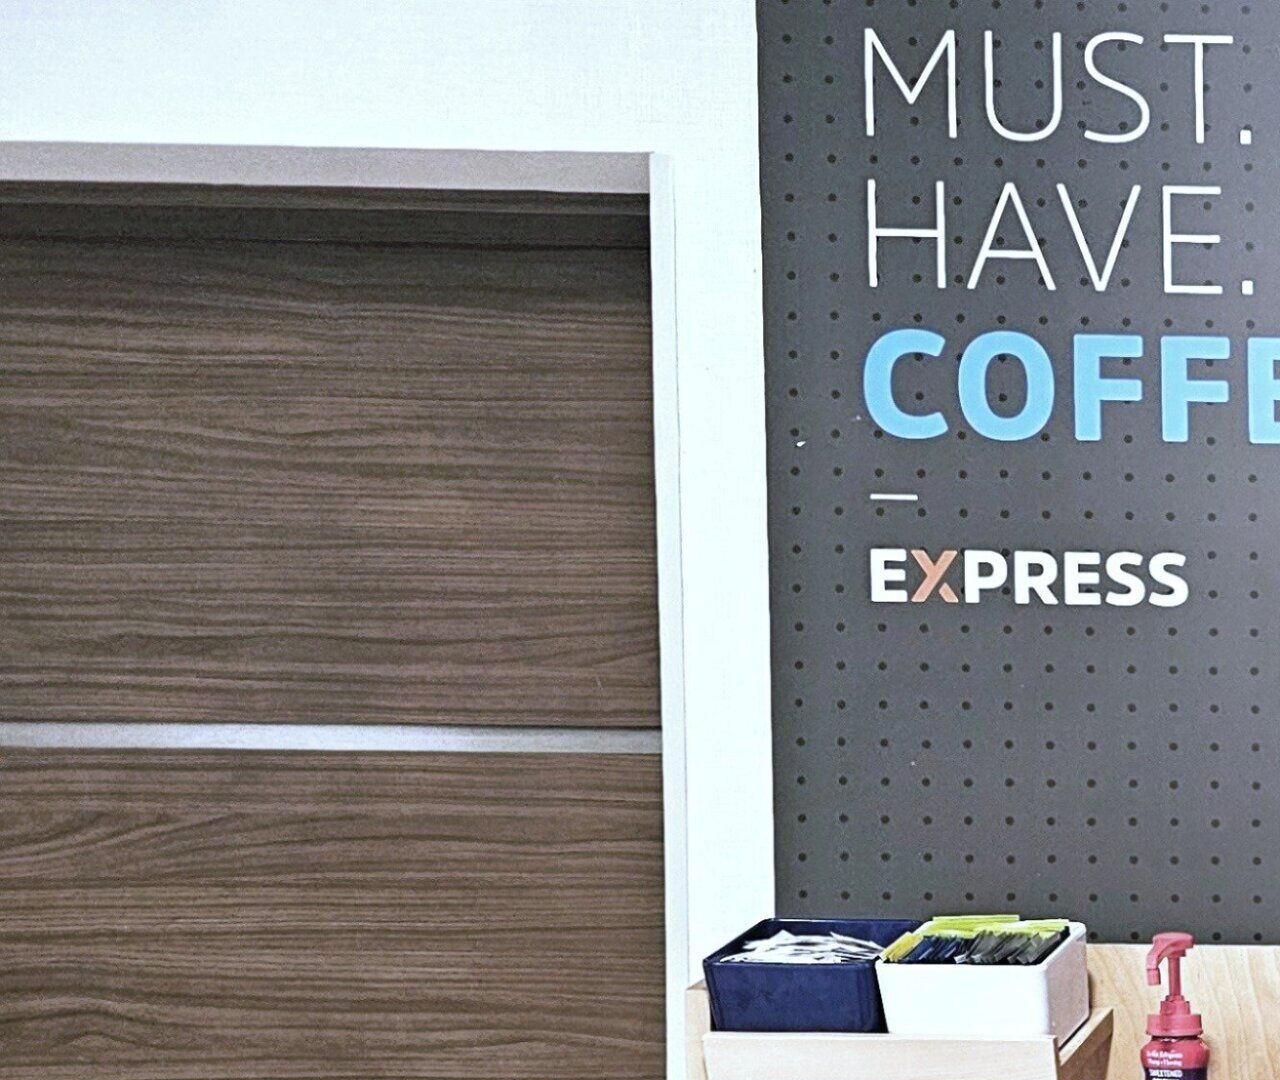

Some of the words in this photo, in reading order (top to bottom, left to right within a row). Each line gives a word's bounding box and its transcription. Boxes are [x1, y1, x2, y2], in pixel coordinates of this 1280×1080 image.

[863, 28, 1252, 144] MUST.
[866, 179, 1254, 295] HAVE.
[869, 547, 1189, 607] EXPRESS
